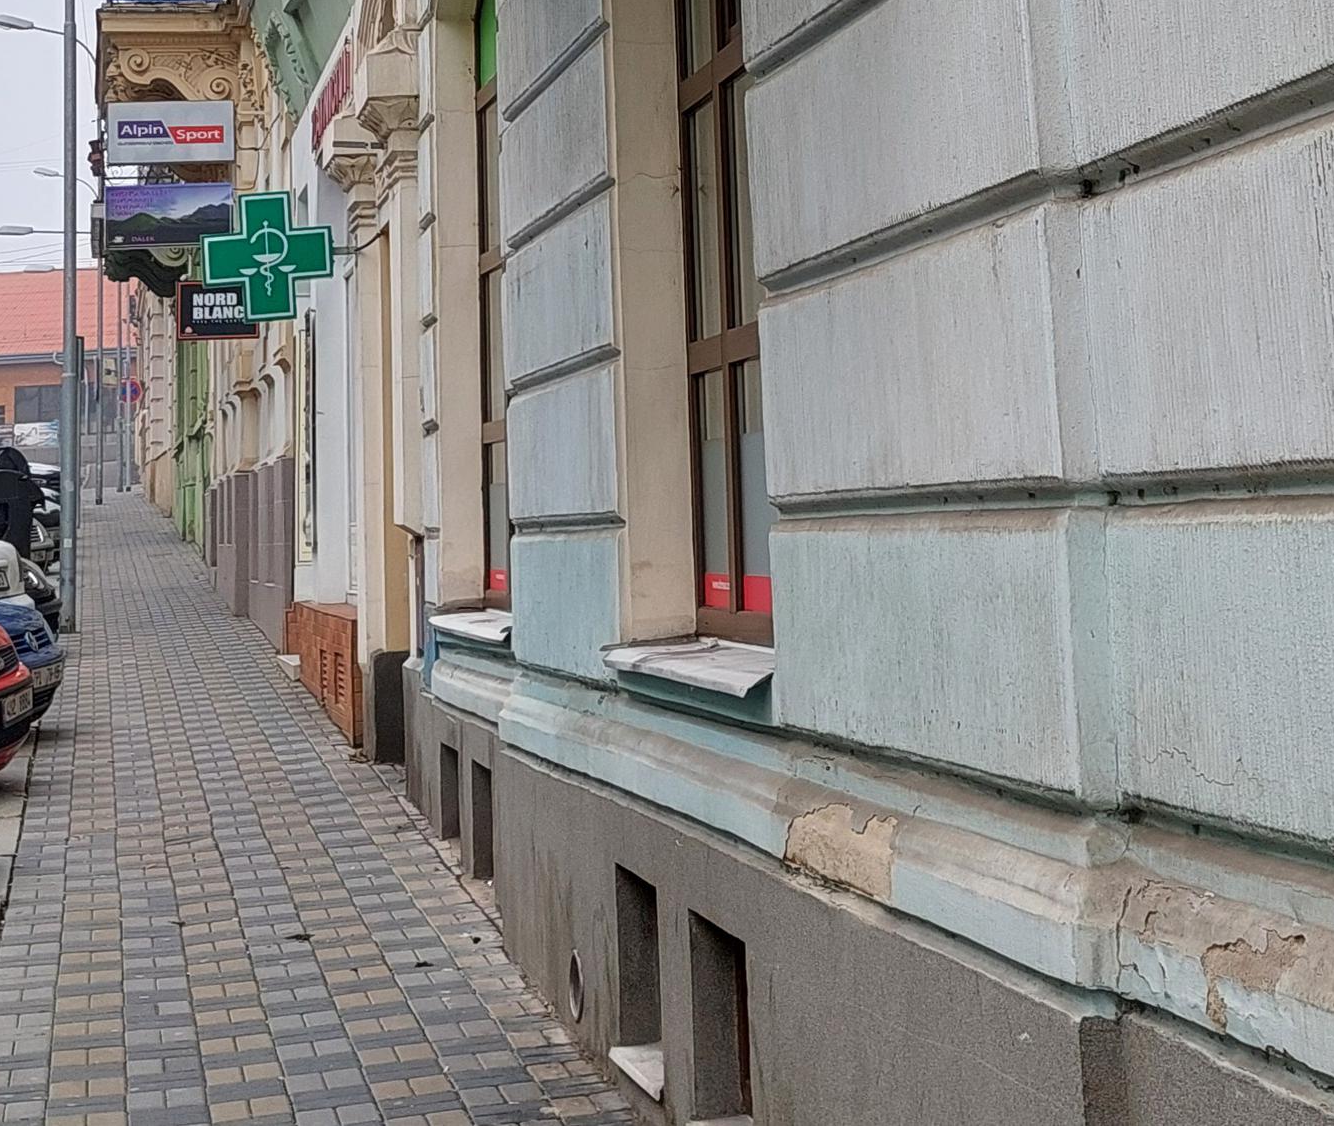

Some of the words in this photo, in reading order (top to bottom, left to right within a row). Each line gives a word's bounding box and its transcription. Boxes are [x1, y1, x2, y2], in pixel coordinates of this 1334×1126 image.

[120, 124, 163, 137] Alpin
[176, 128, 221, 142] Sport
[192, 292, 237, 306] NORD
[192, 306, 245, 320] BLANC
